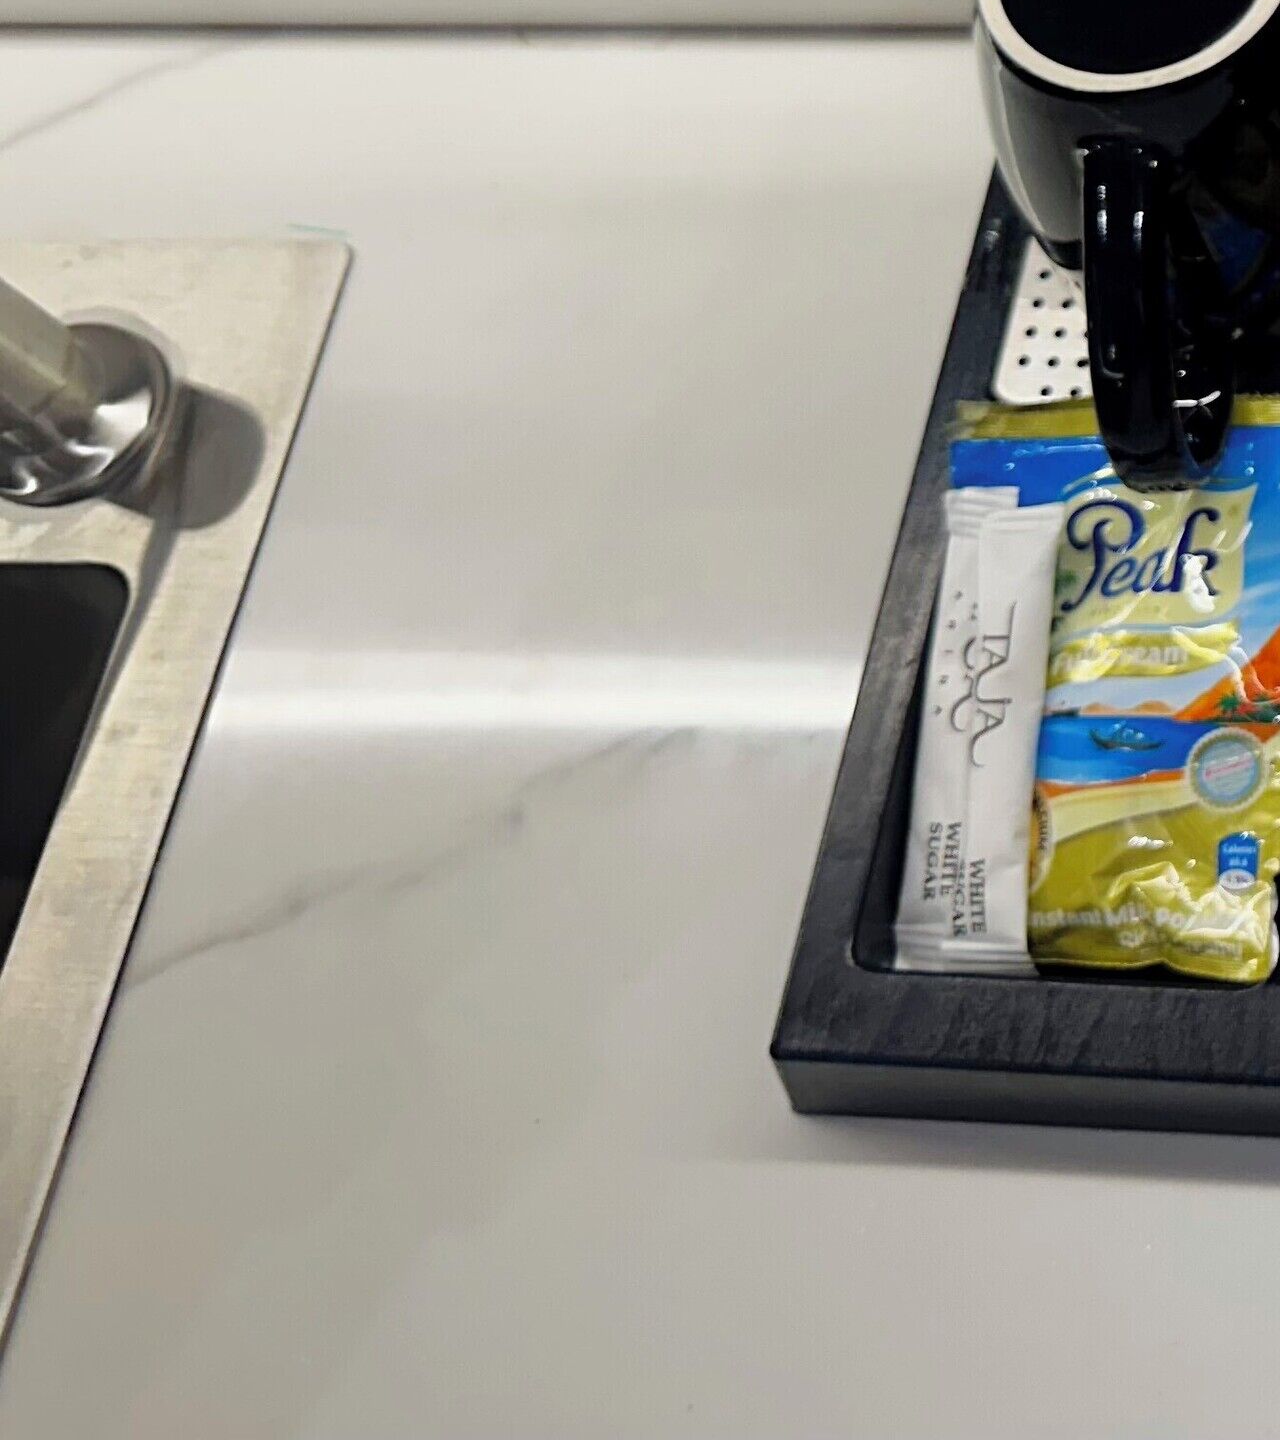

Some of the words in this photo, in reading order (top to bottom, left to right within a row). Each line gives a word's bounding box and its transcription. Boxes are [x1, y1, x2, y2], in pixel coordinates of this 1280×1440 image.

[1061, 498, 1219, 613] Peak
[922, 822, 943, 900] SUGAR
[940, 821, 962, 896] WHITE
[969, 858, 987, 933] WHITE
